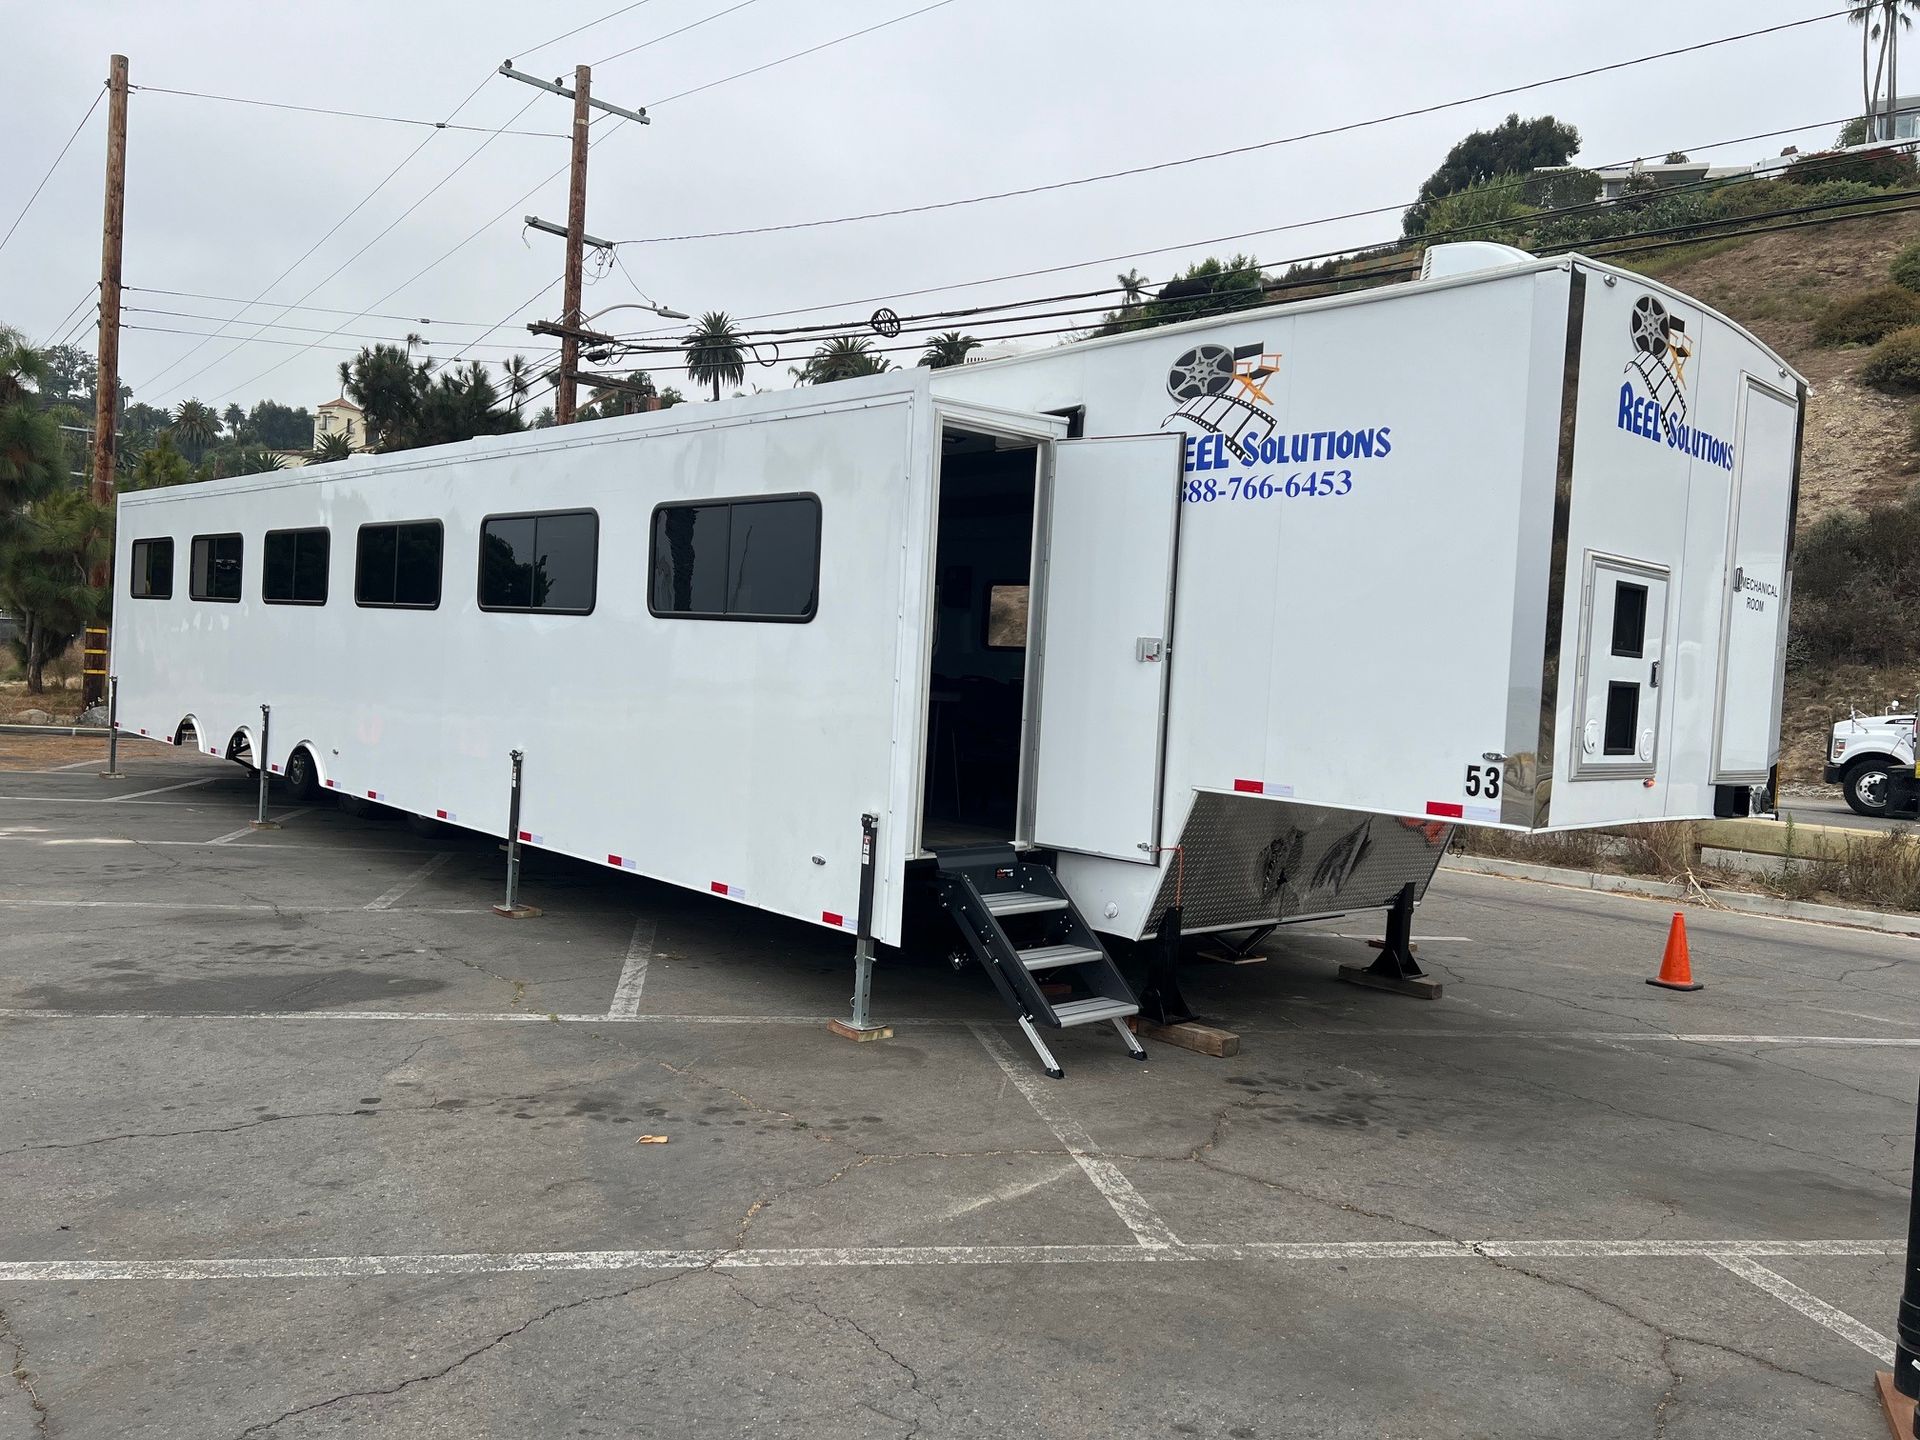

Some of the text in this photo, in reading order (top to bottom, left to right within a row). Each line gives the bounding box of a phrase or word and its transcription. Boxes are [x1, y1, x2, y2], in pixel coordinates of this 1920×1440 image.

[1618, 381, 1734, 472] REEL SOLUTIONS
[1241, 427, 1391, 467] SOLUTIONS
[1742, 576, 1778, 598] MECHANICAL
[1746, 597, 1764, 612] ROOM
[1465, 765, 1500, 799] 53
